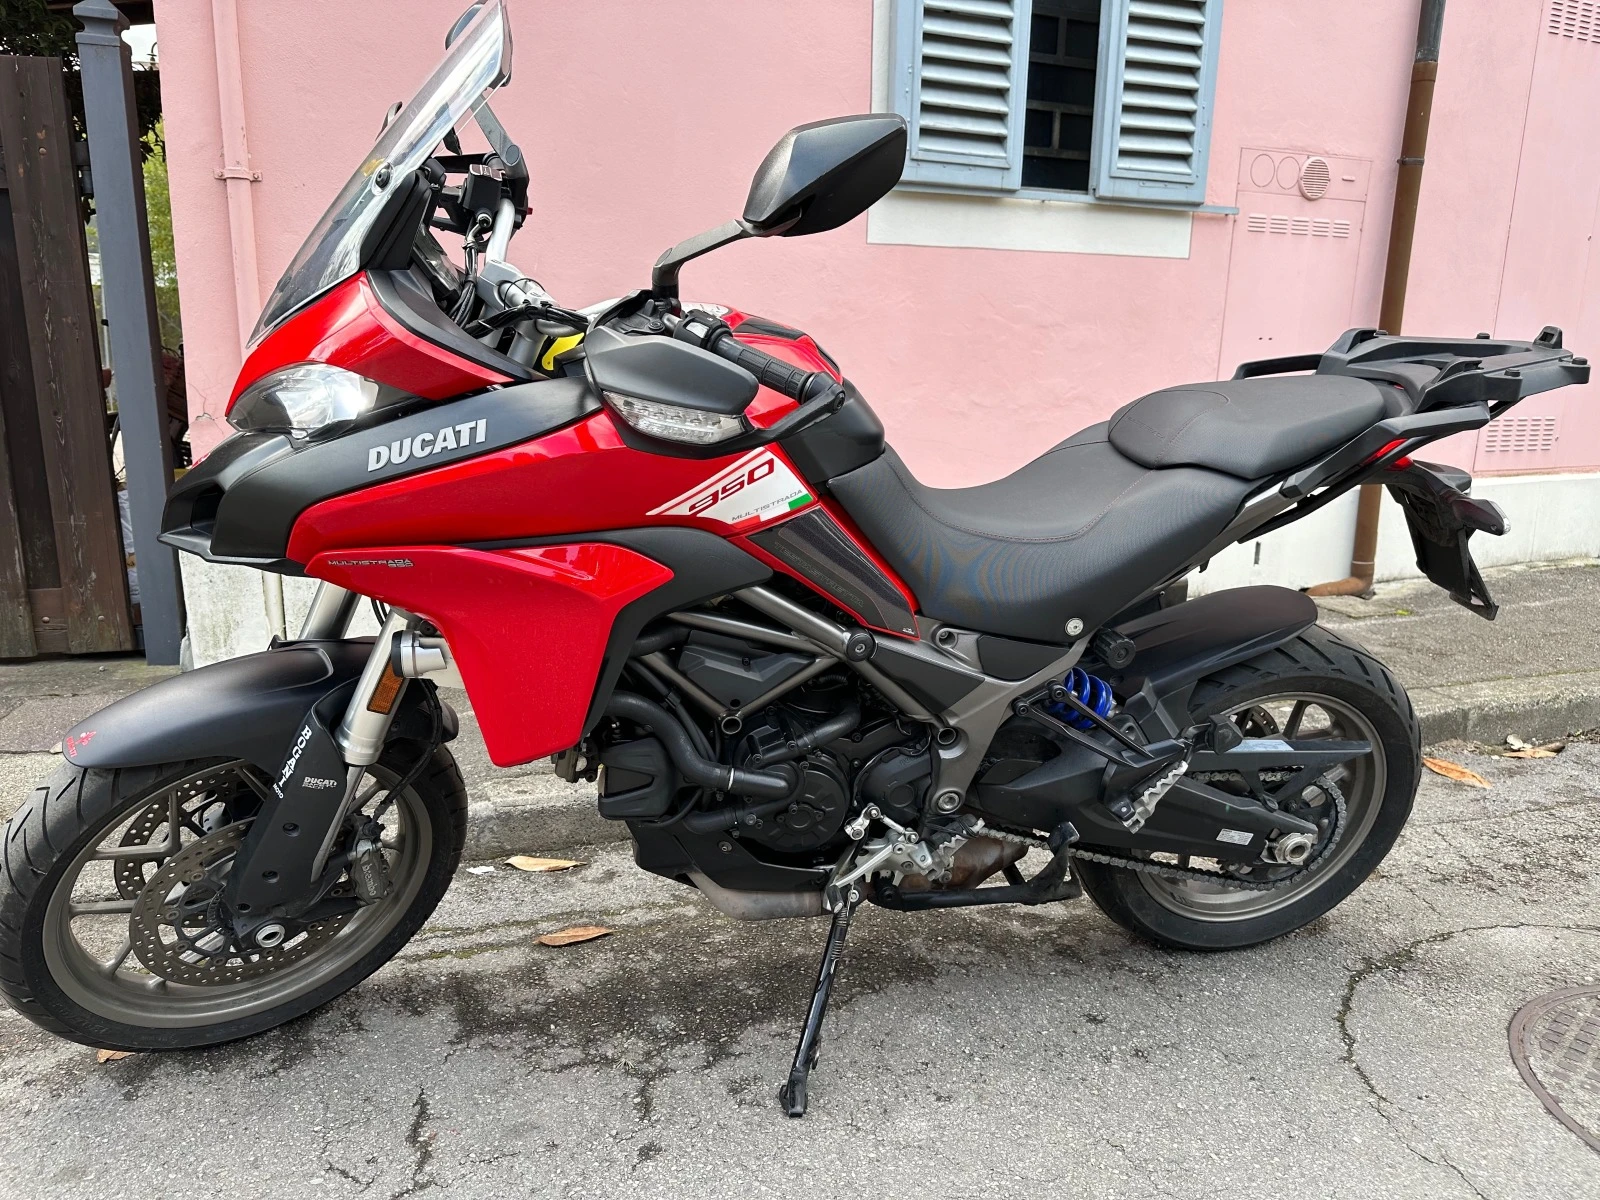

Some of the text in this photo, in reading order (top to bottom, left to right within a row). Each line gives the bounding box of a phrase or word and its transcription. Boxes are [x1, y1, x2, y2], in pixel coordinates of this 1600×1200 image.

[367, 418, 487, 472] DUCATI
[688, 457, 775, 515] 950
[731, 488, 803, 521] MULTISTRADA
[327, 558, 413, 566] MULTISTRADA
[278, 724, 313, 788] BOGANI
[304, 776, 338, 787] DUCATI
[361, 863, 378, 897] brembo
